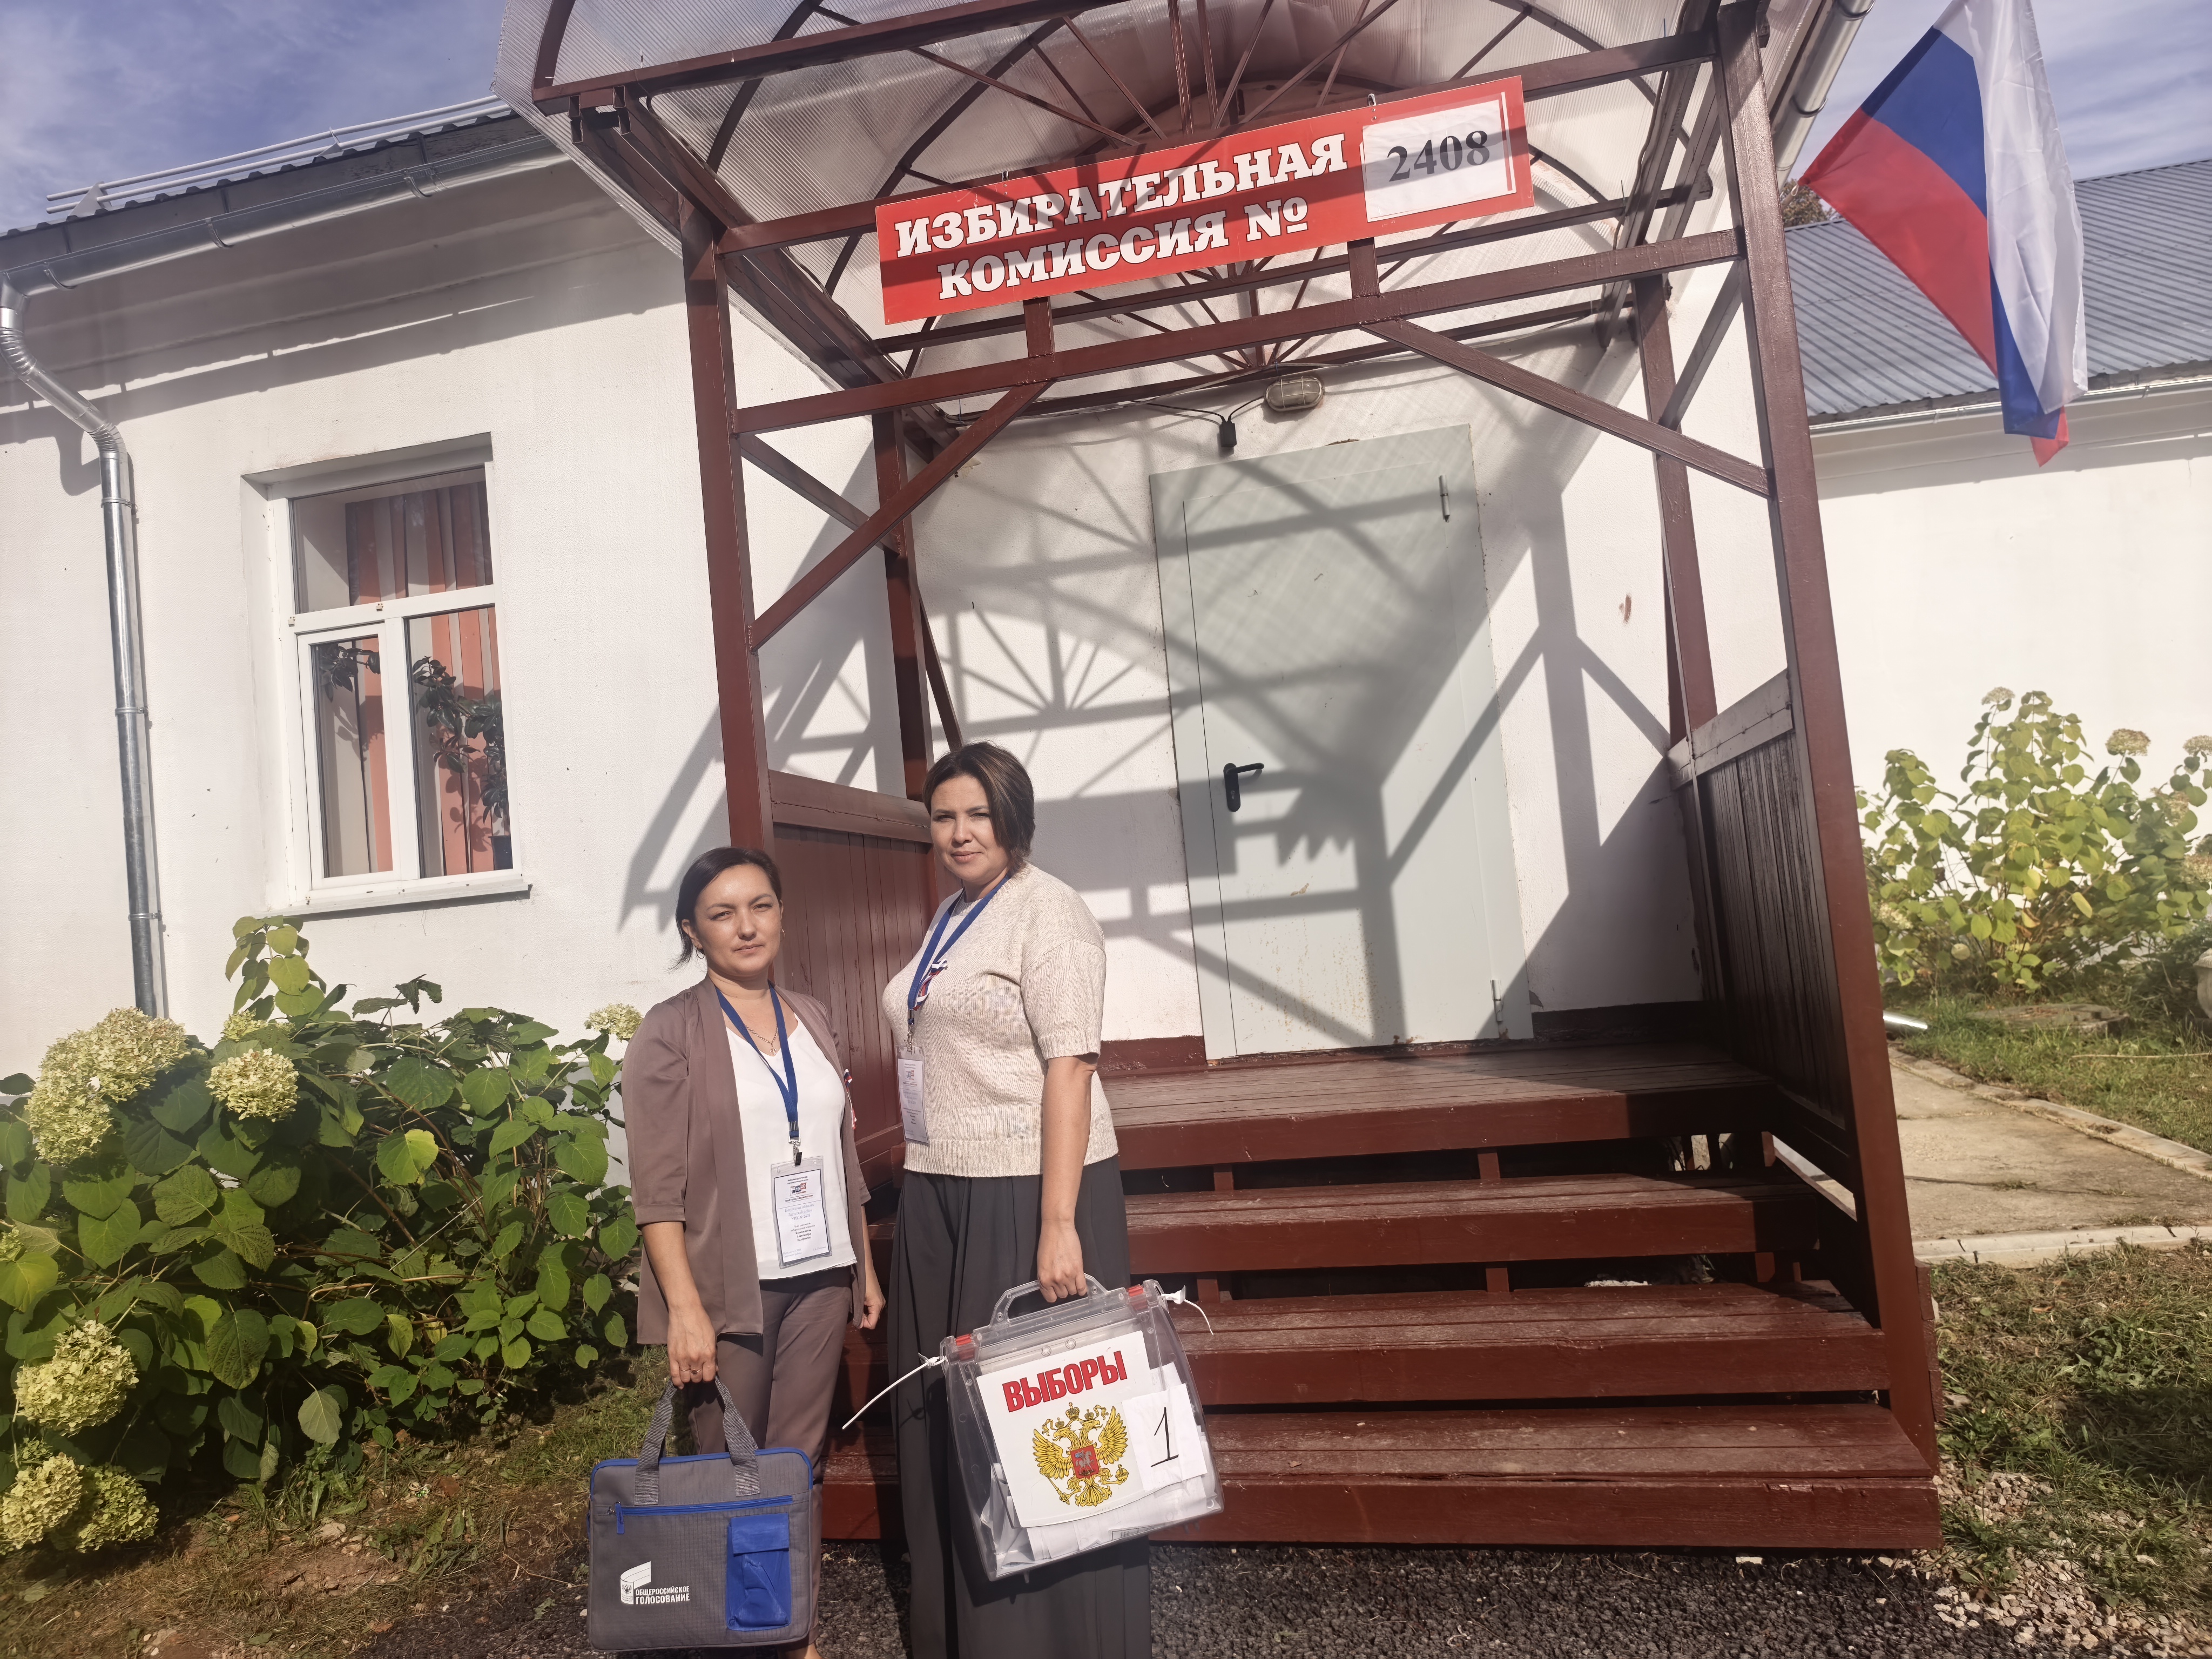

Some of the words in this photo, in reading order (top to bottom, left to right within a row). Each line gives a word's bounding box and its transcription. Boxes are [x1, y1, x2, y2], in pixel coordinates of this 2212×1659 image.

[1386, 130, 1491, 183] 2408
[895, 132, 1347, 258] ИЗБИРАТЕЛЬНАЯ
[938, 212, 1230, 300] КОМИССИЯ
[1244, 195, 1309, 242] №
[1002, 1351, 1128, 1413] ВЫБОРЫ
[1150, 1406, 1179, 1467] 1
[636, 1586, 690, 1596] ОБЩЕРОССИЙСКОЕ
[636, 1593, 690, 1604] ГОЛОСОВАНИЕ
